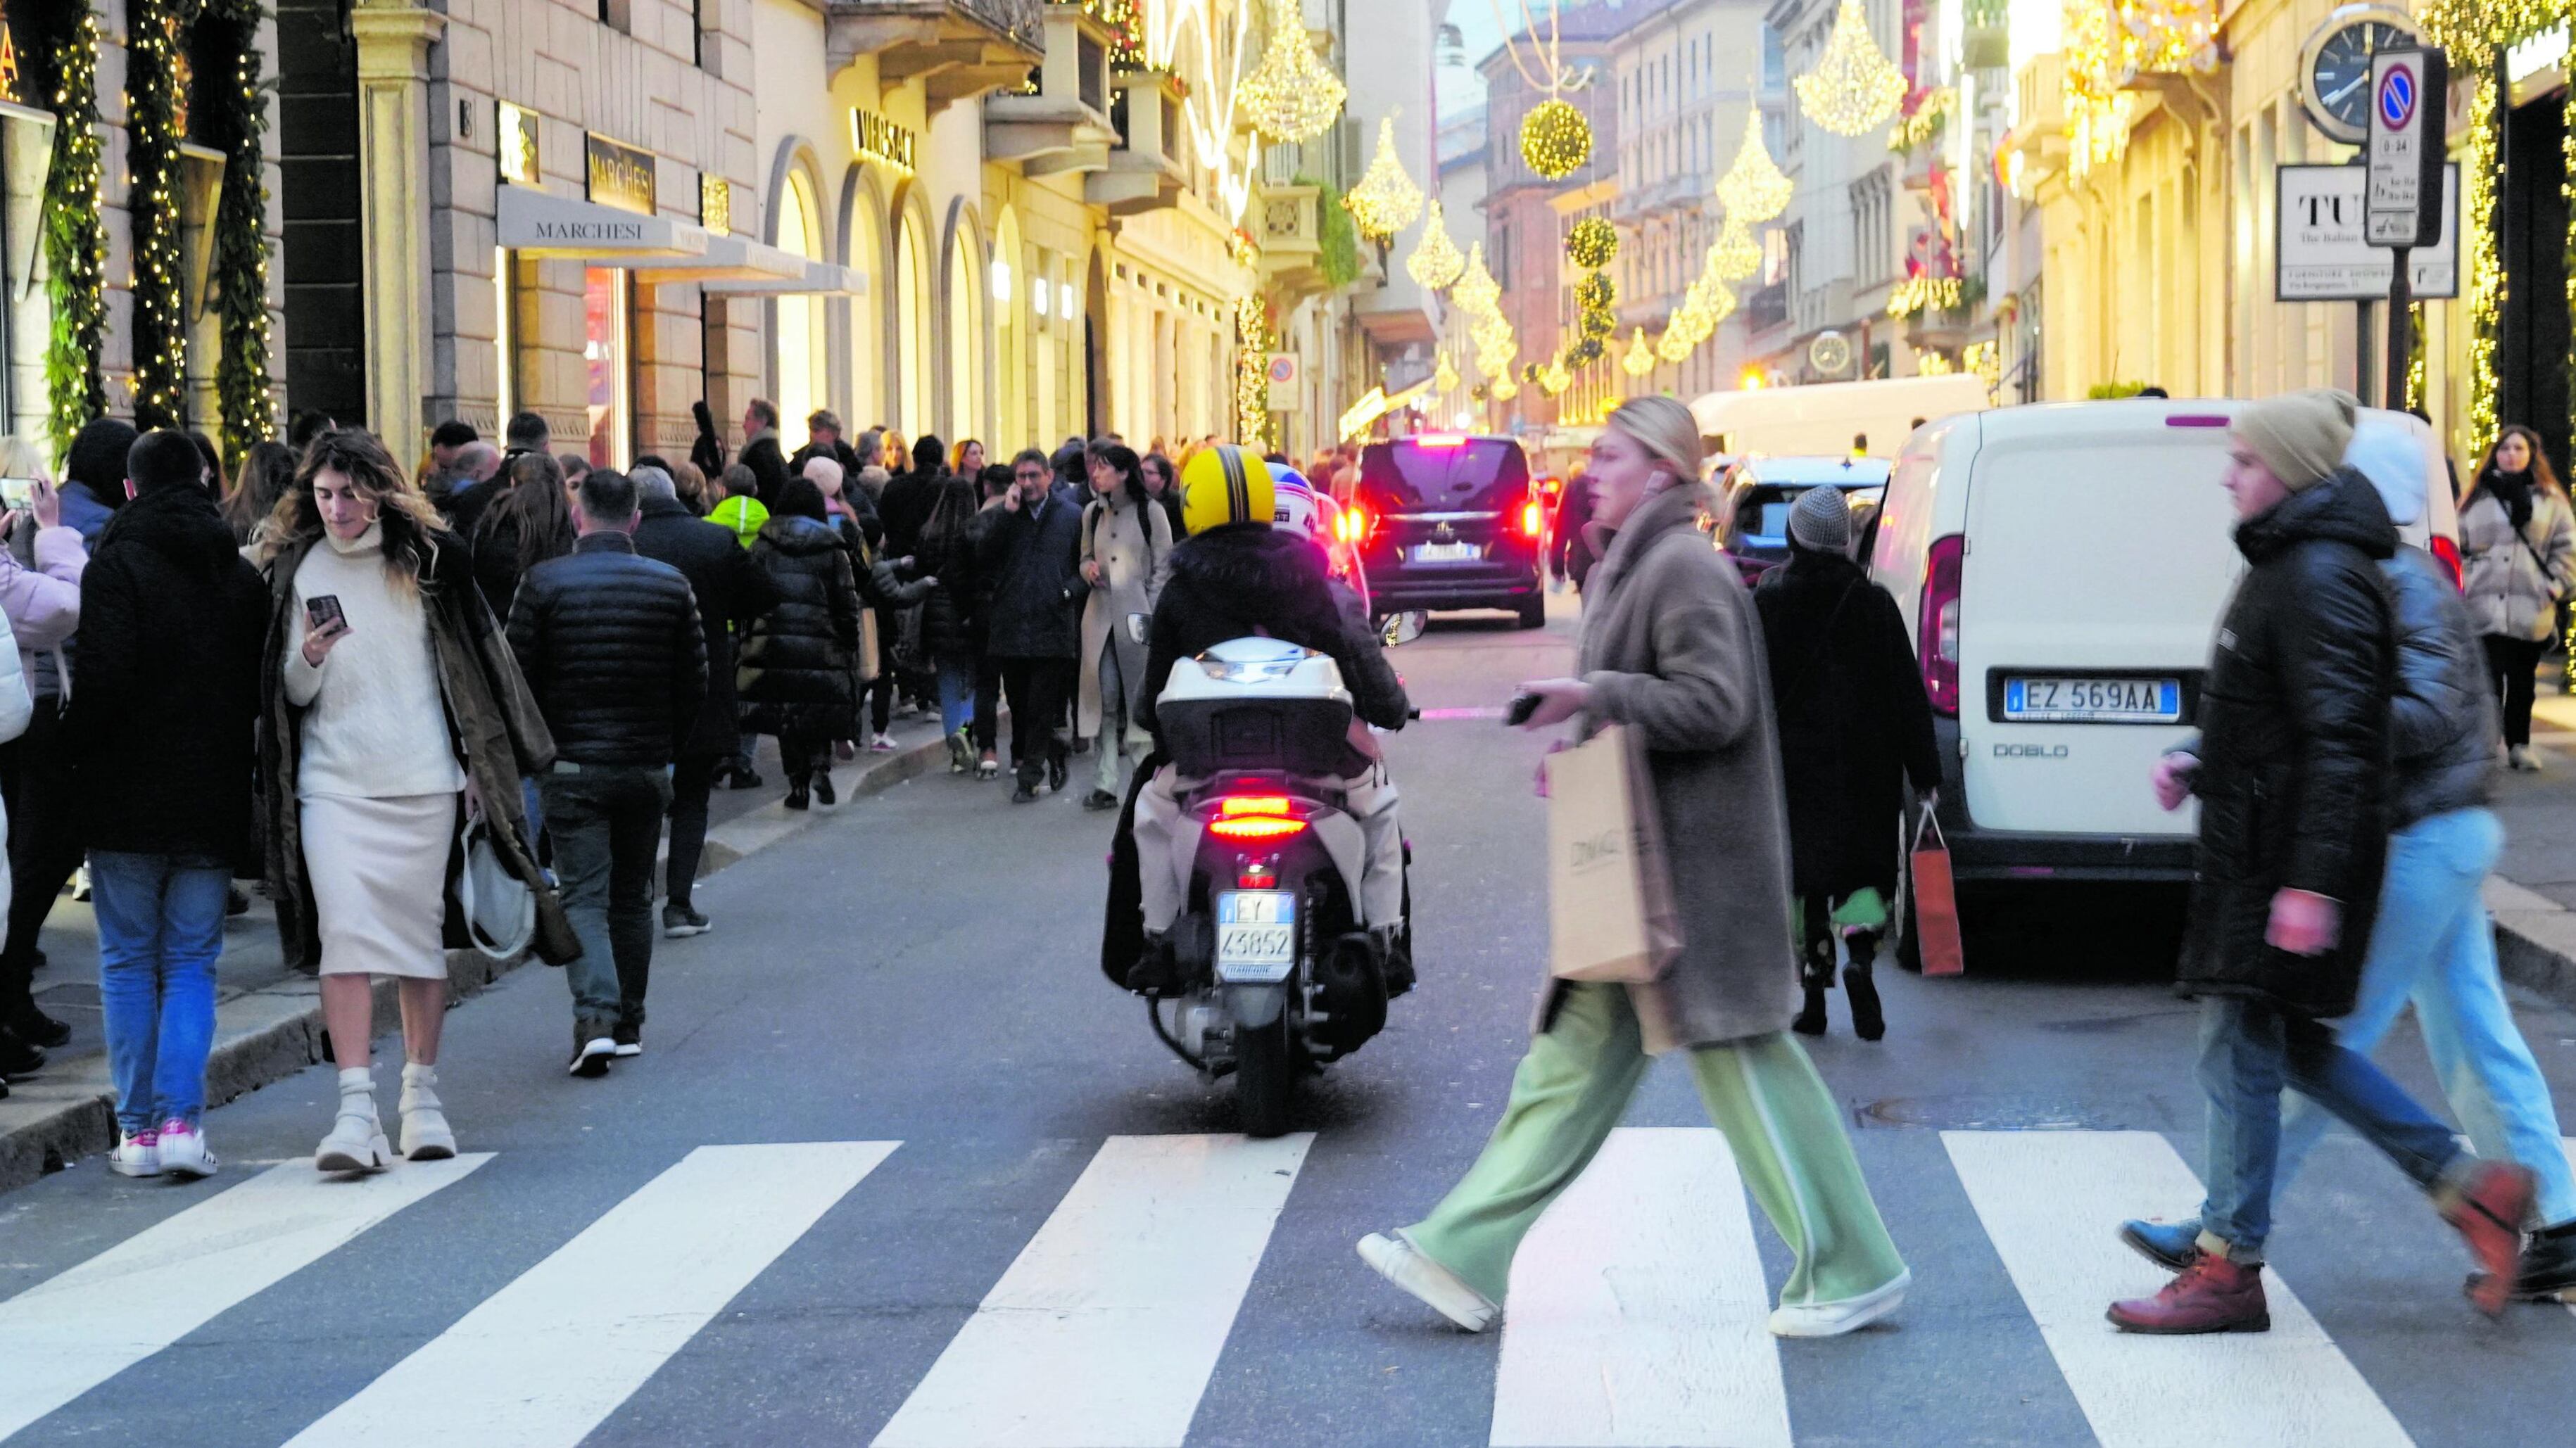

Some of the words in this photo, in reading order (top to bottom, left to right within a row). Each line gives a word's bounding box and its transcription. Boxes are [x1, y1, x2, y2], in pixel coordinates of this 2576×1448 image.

[589, 151, 654, 201] MARCHESI
[536, 222, 641, 240] MARCHESI
[2027, 681, 2059, 709] EZ
[2071, 681, 2156, 710] 569AA
